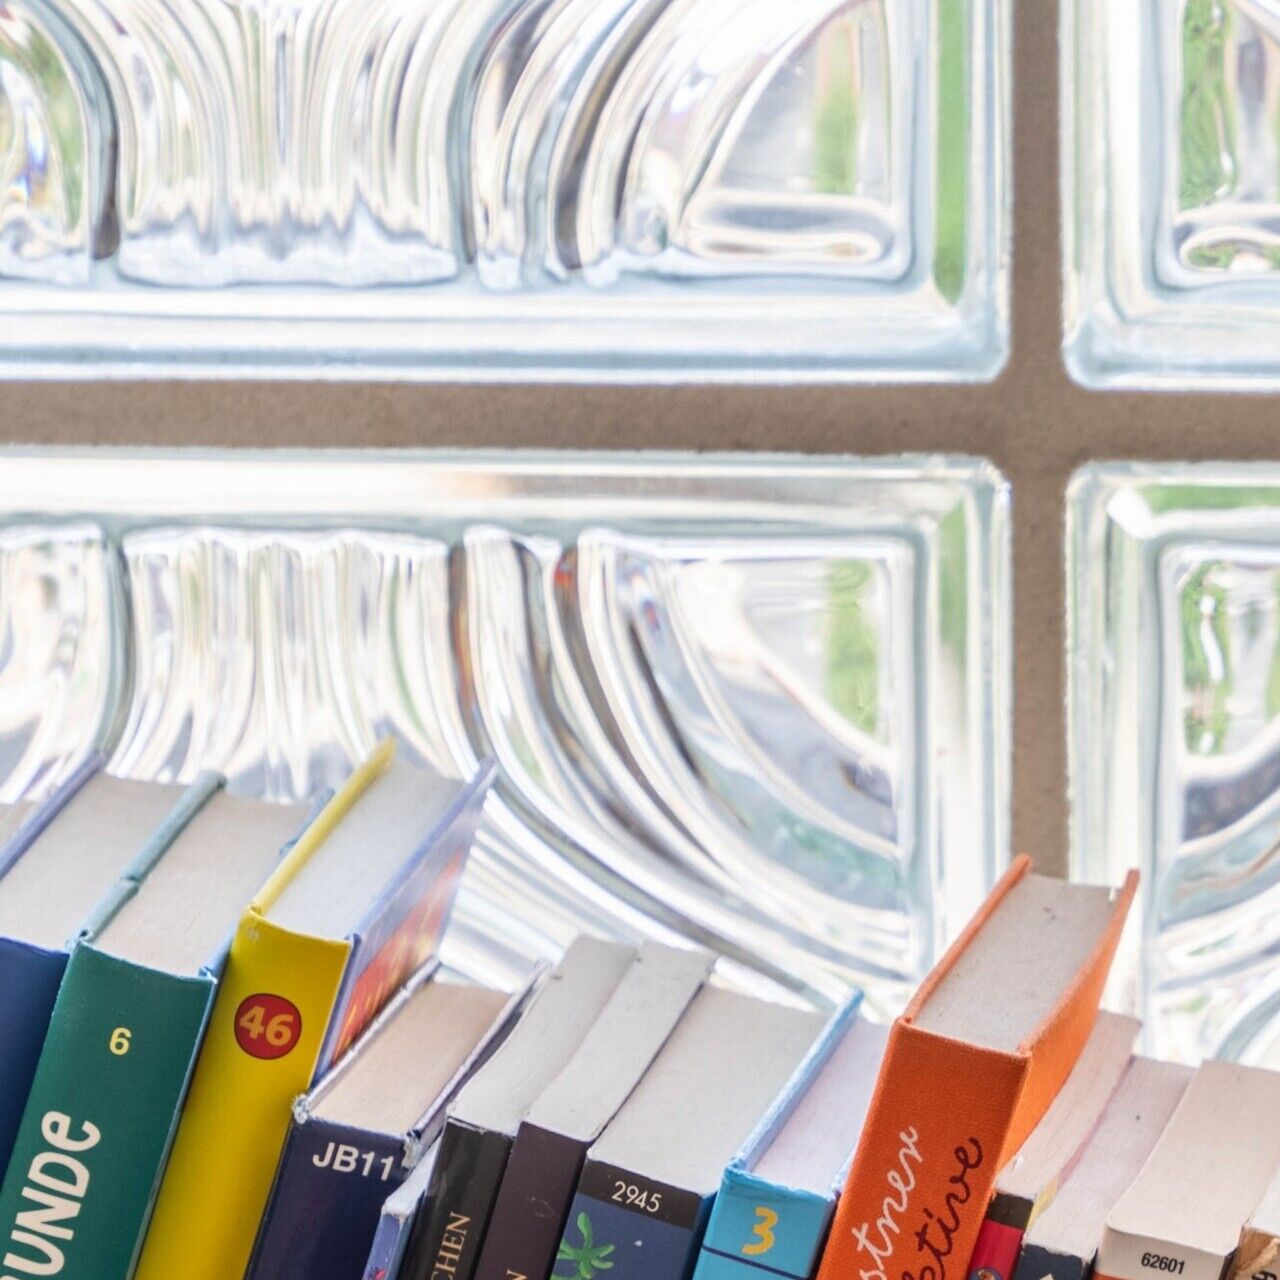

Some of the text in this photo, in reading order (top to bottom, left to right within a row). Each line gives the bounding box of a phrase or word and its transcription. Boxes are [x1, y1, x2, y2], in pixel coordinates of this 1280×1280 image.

[238, 1005, 294, 1047] 46
[312, 1142, 394, 1180] JB11
[611, 1182, 660, 1213] 2945
[742, 1207, 779, 1255] 3
[1140, 1251, 1185, 1276] 62601
